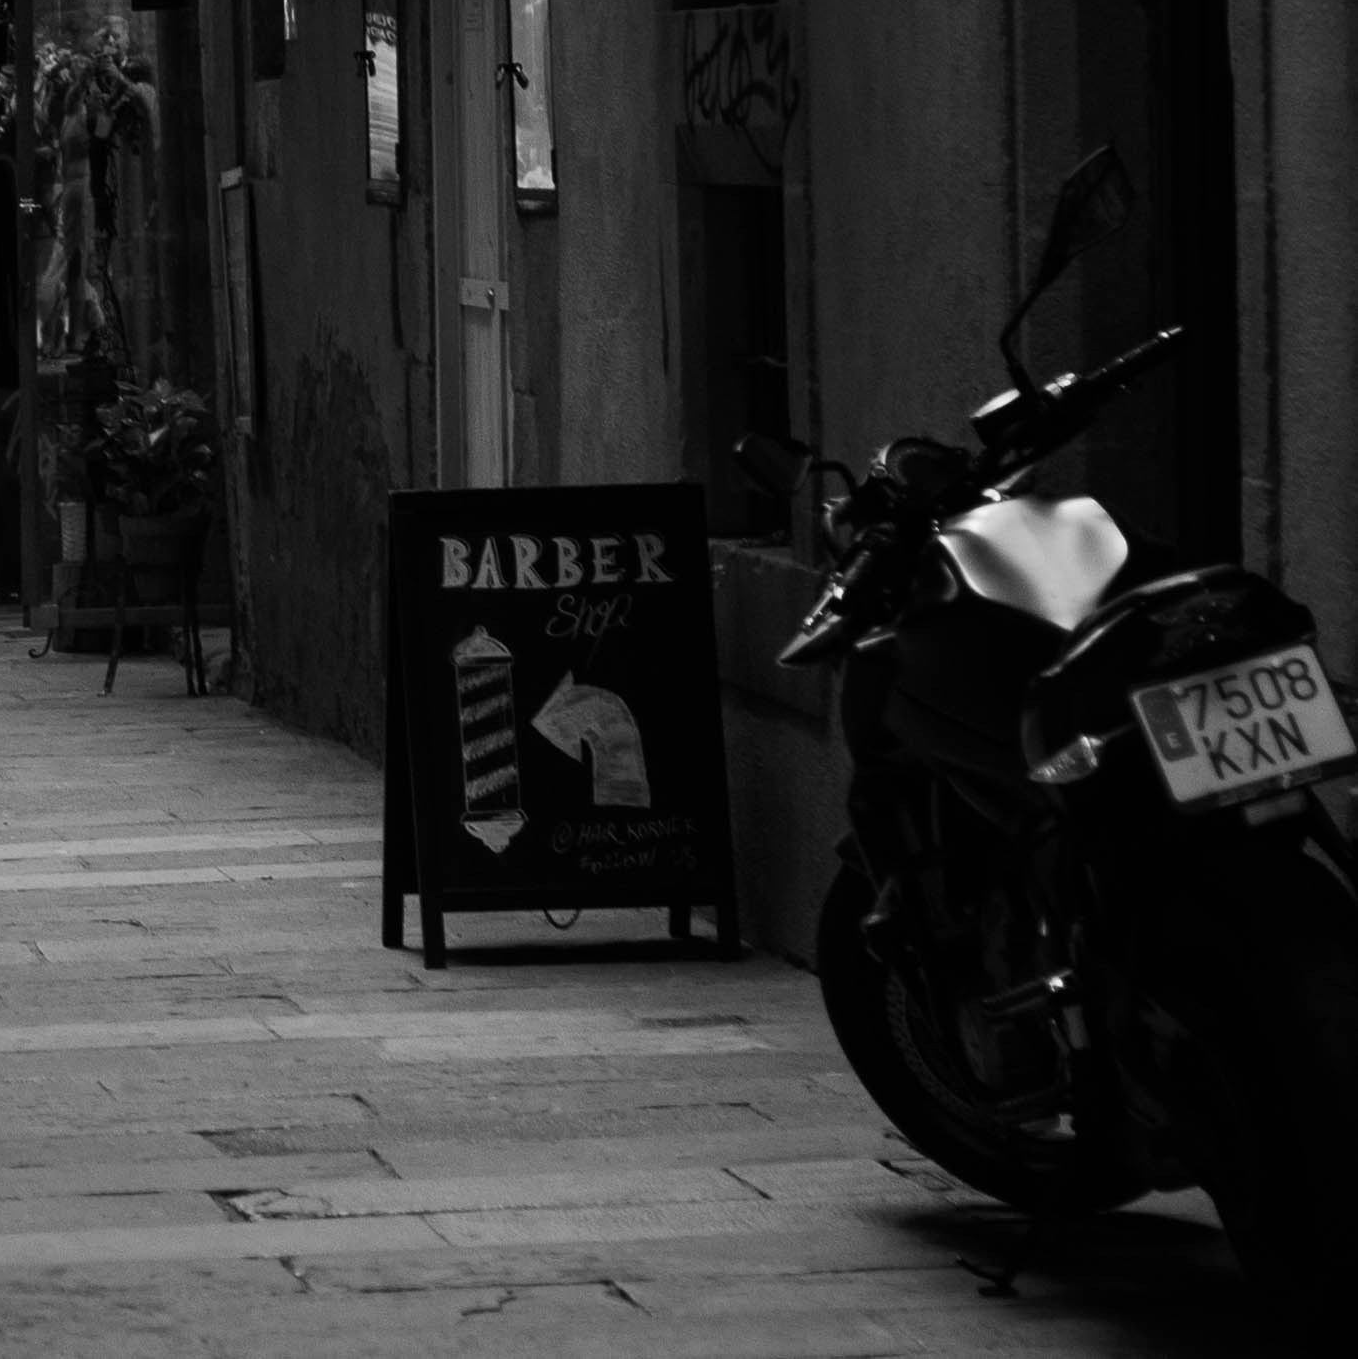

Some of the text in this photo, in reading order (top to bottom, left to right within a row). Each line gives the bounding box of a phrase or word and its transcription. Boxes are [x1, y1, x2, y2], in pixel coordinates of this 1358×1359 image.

[438, 531, 677, 590] BARBER
[1177, 658, 1319, 731] 7508
[1164, 731, 1182, 749] E
[1202, 712, 1311, 780] KXN
